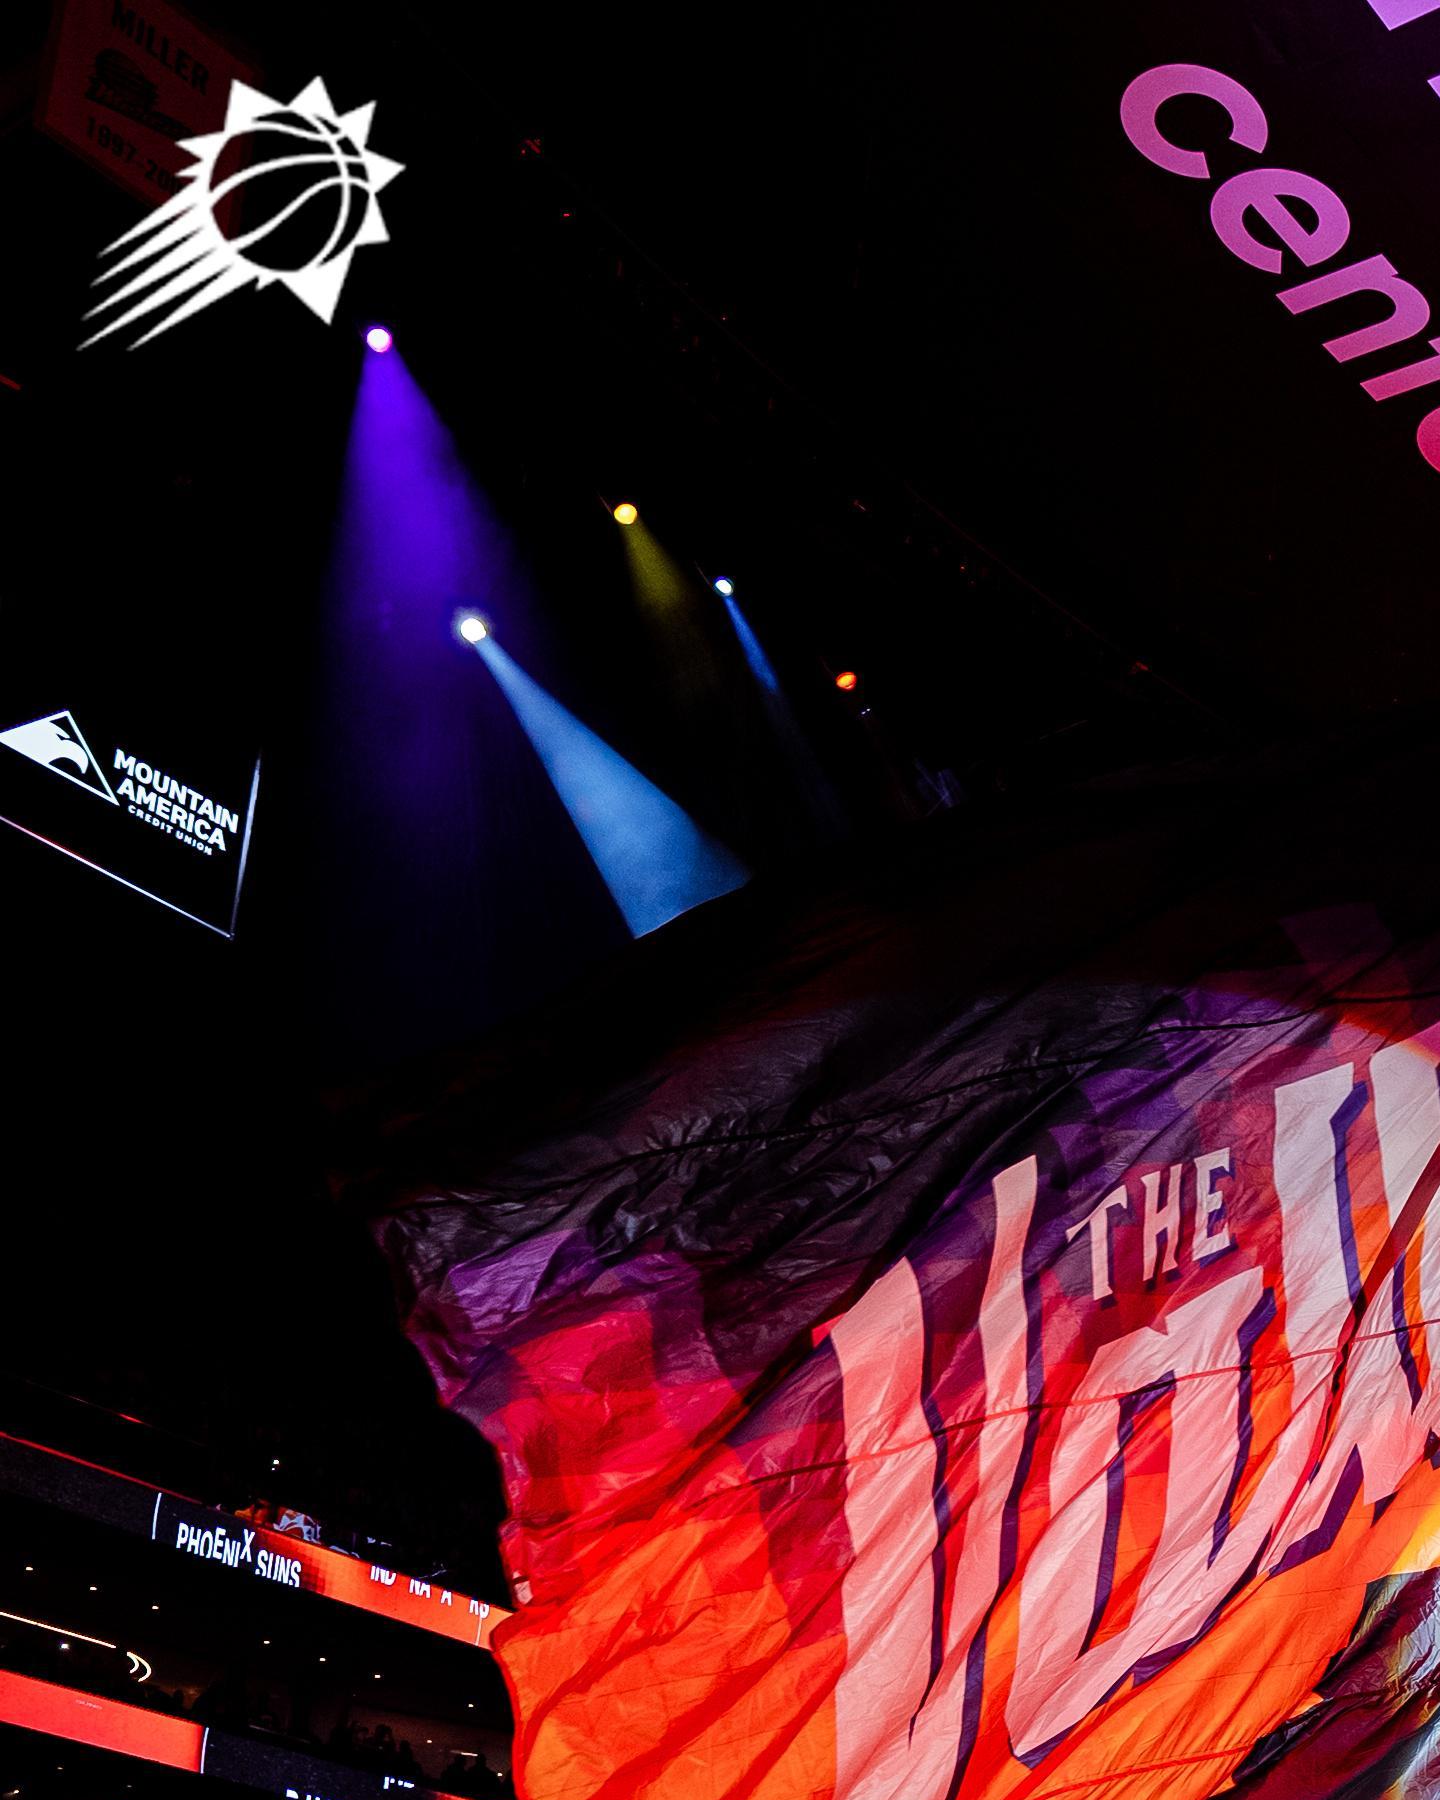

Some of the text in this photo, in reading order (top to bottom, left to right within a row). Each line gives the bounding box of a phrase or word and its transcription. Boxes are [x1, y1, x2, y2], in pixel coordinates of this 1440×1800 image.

[114, 748, 239, 834] MOUNTAIN
[116, 777, 226, 851] AMERICA
[127, 804, 213, 856] CREDIT UNION
[1066, 1147, 1238, 1301] THE
[175, 1522, 302, 1588] PHOENIX SUNS
